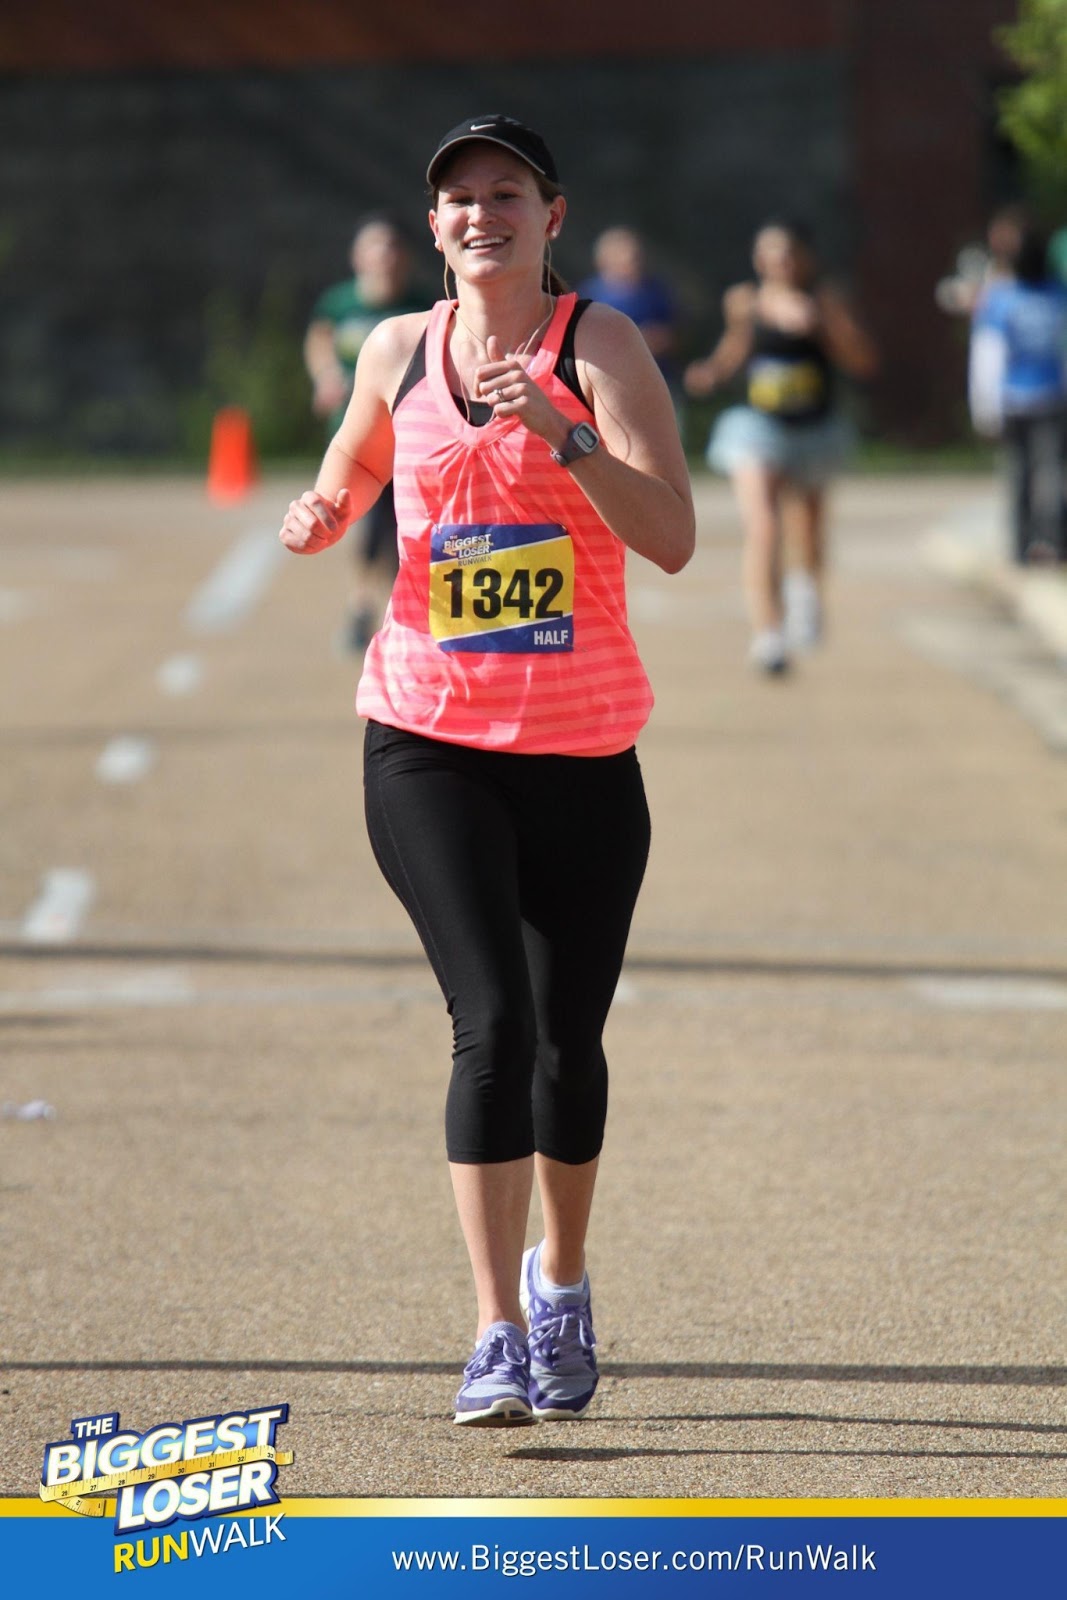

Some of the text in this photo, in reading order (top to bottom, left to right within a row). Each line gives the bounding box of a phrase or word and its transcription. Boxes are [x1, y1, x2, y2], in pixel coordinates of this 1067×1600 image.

[444, 534, 491, 550] BIGGEST
[458, 545, 490, 559] LOSER
[457, 555, 492, 567] RUNWALK
[443, 568, 564, 619] 1342
[534, 630, 568, 645] HALF
